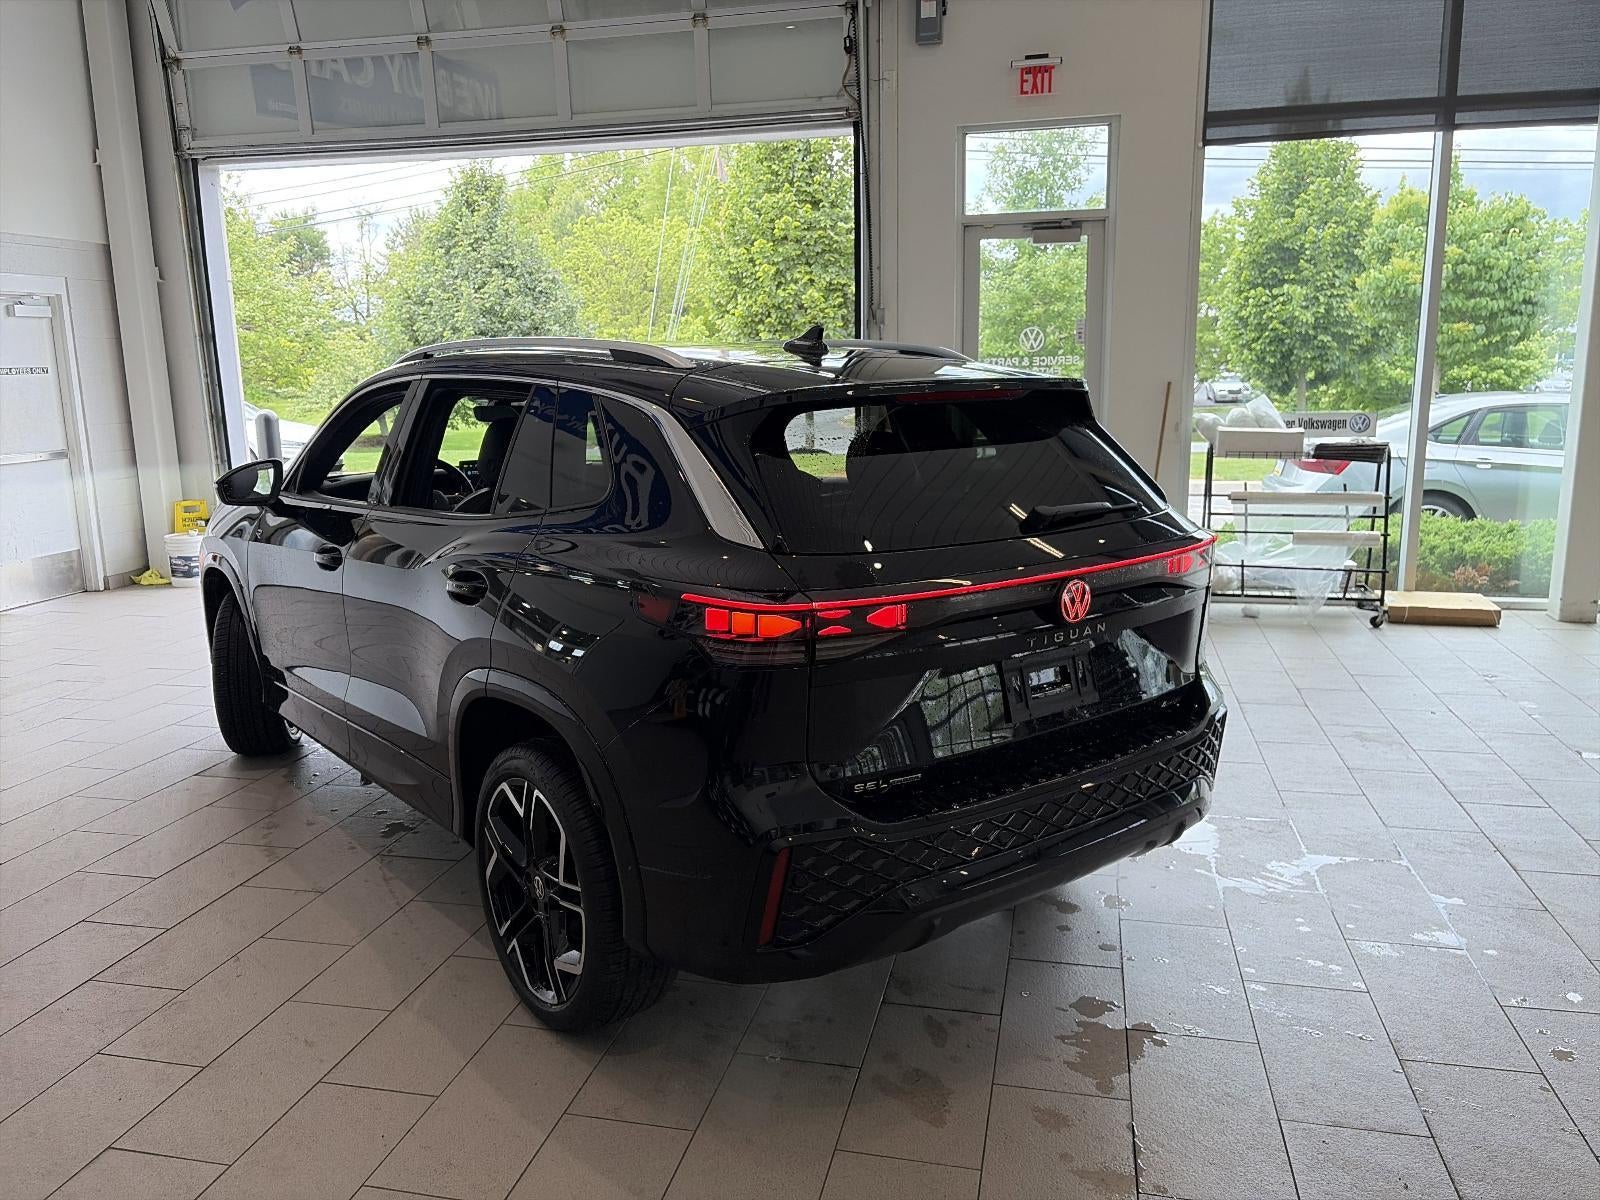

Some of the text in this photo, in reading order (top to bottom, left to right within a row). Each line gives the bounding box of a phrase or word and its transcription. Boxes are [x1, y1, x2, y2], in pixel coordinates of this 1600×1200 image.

[1020, 65, 1055, 95] EXIT
[0, 367, 31, 375] MPLOYEES
[1283, 419, 1296, 428] er
[1298, 417, 1347, 431] Volkswagen
[1027, 622, 1106, 647] TIGUAN
[854, 780, 888, 793] SEL
